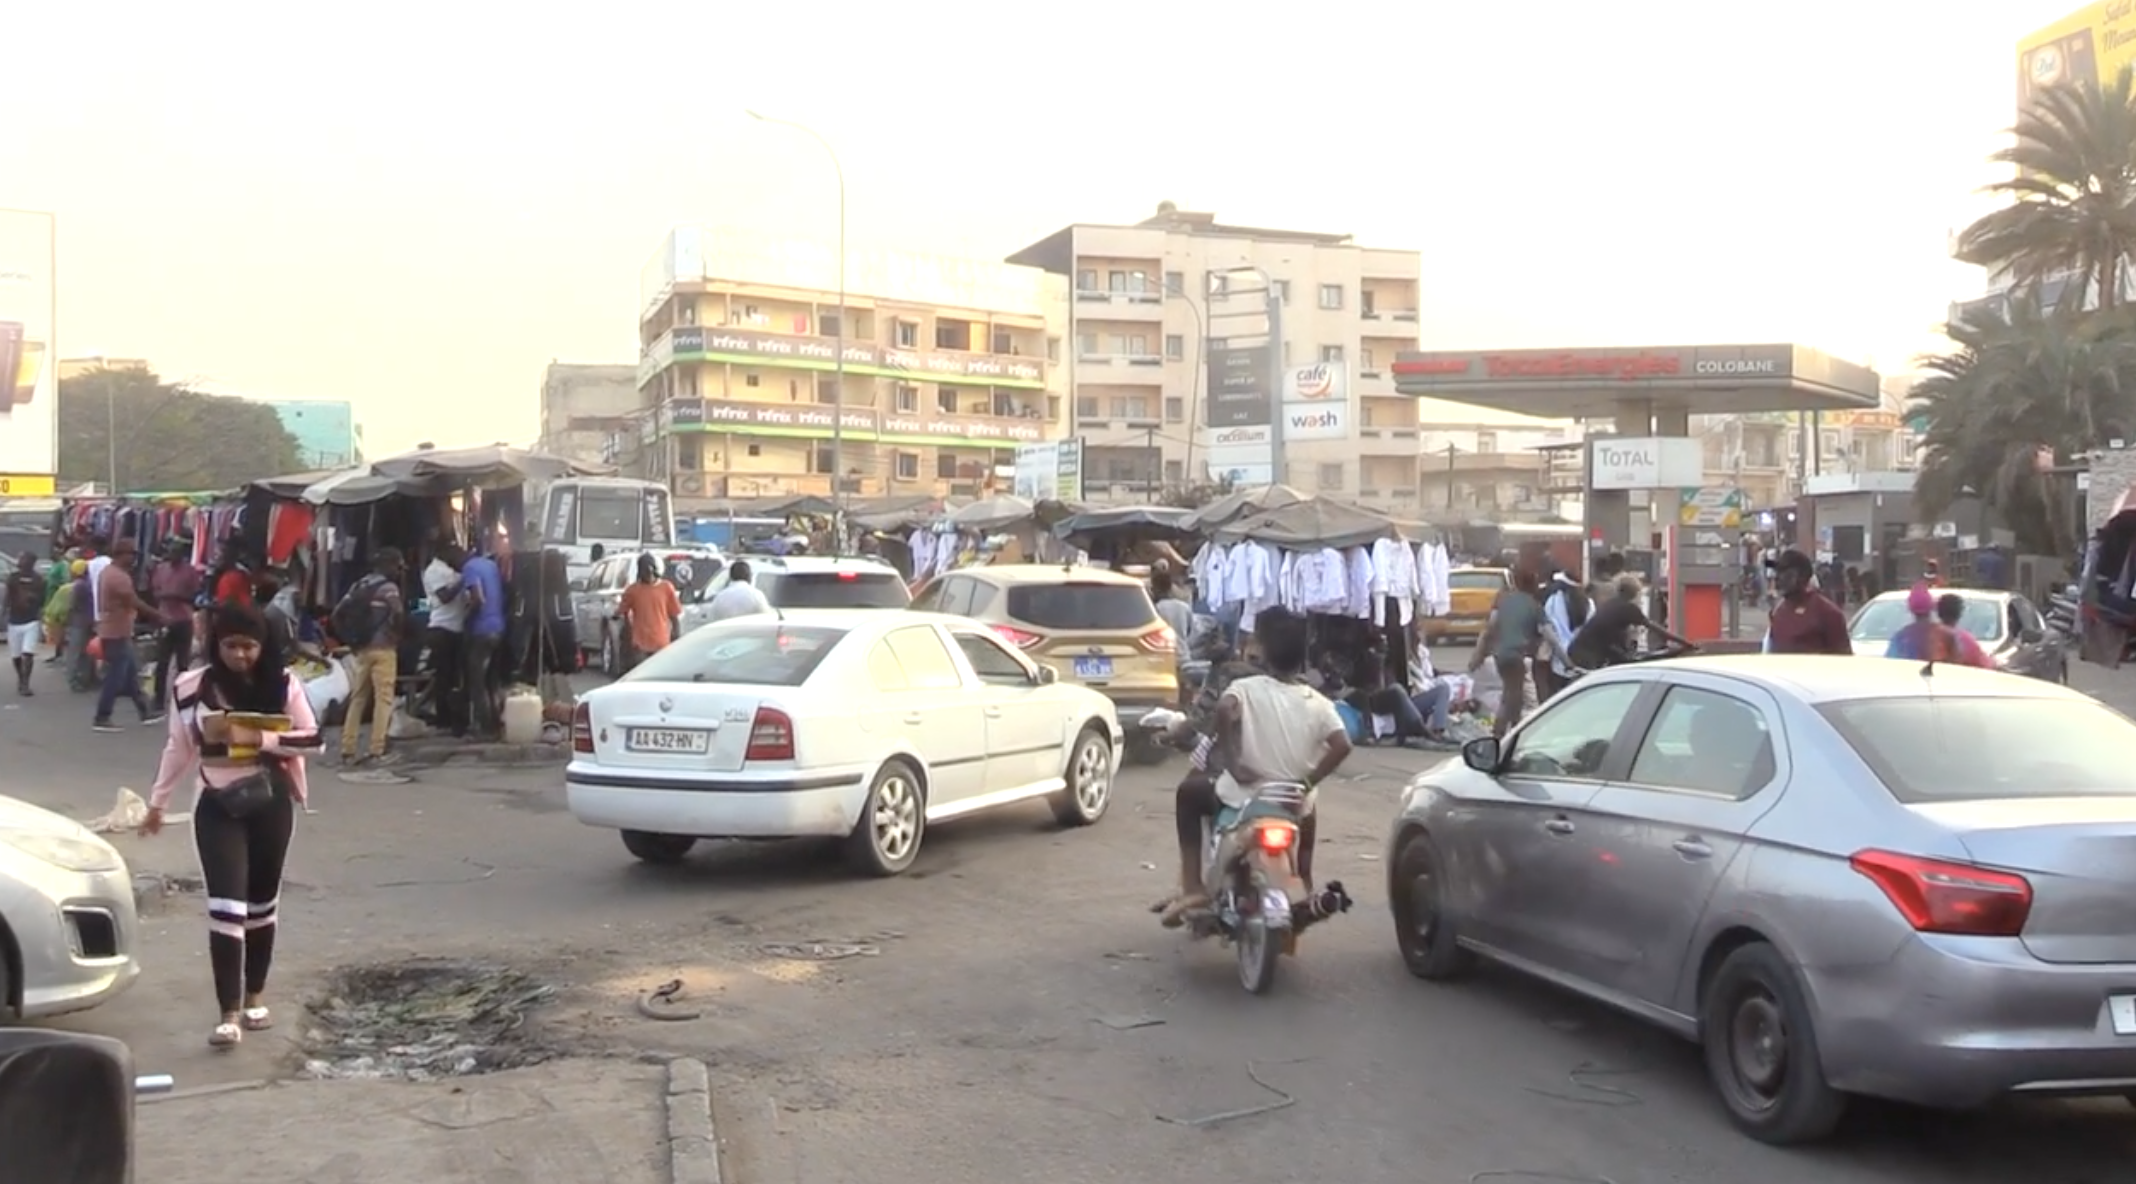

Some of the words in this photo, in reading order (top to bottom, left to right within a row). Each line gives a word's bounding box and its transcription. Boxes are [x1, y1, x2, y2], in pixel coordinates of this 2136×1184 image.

[841, 348, 873, 362] nfinix
[1296, 364, 1327, 381] café
[1696, 360, 1775, 373] COLOBANE
[1291, 410, 1338, 428] wash
[1599, 447, 1654, 466] TOTAL
[652, 732, 675, 748] 432
